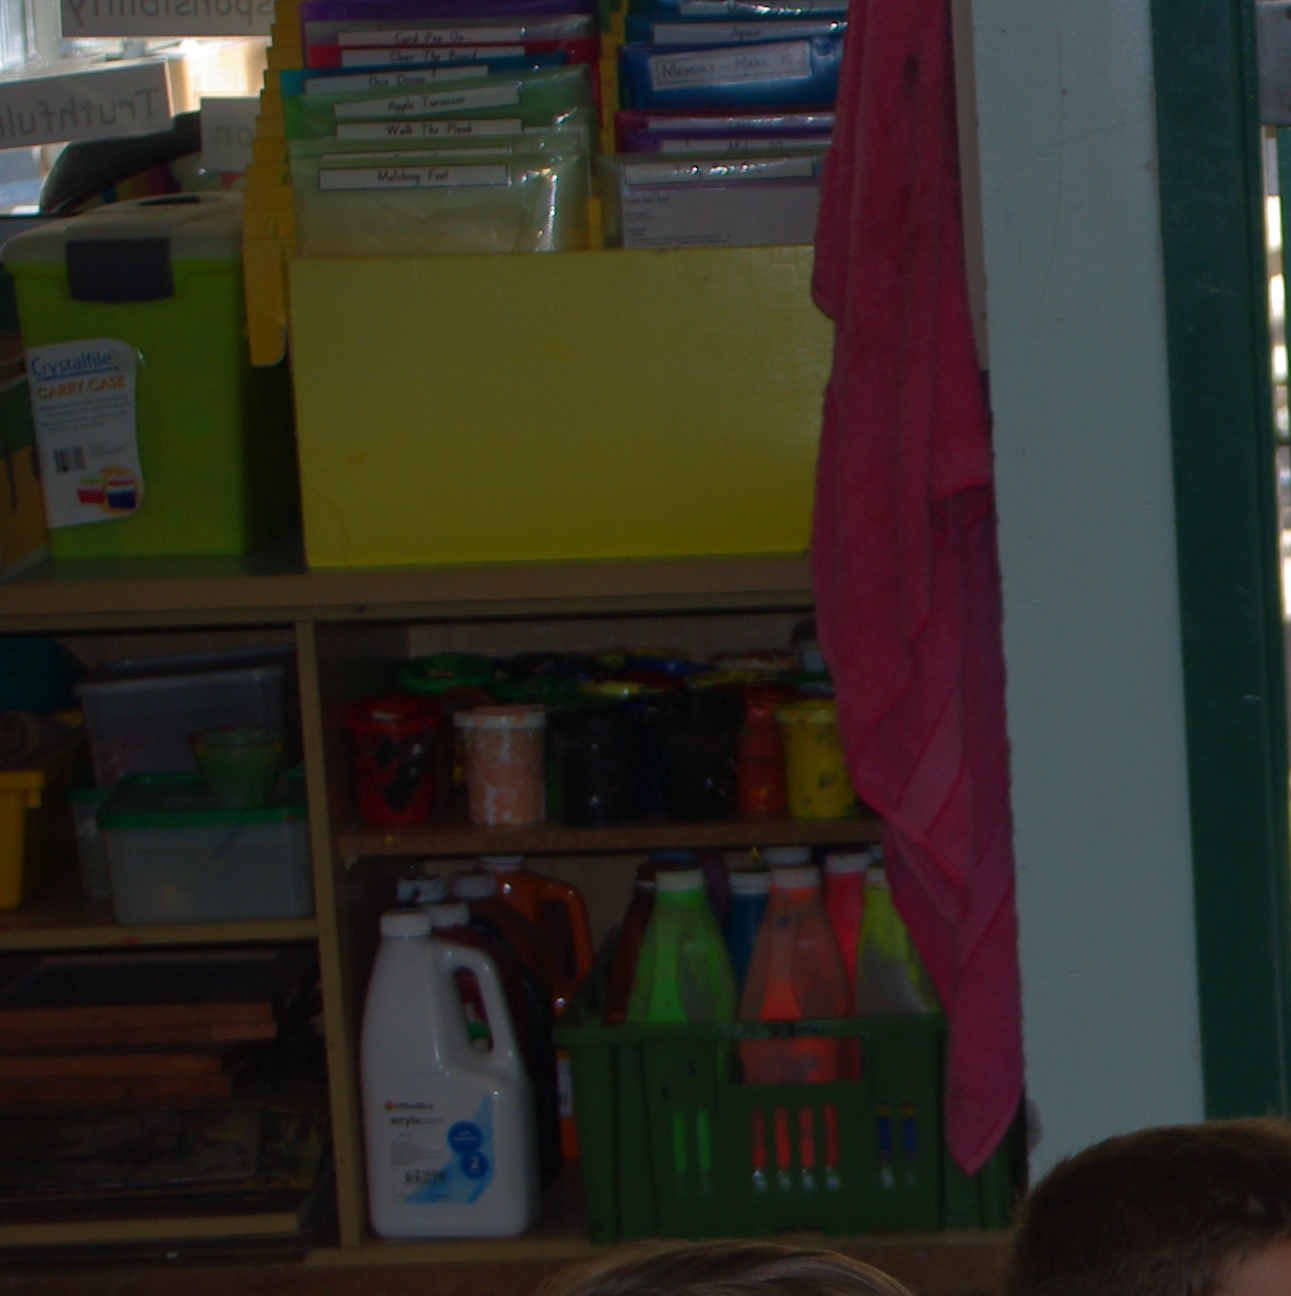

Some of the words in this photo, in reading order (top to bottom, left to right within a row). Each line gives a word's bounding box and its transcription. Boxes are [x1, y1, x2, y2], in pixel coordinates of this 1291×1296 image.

[31, 351, 113, 375] Crystalfile
[37, 381, 83, 399] CARRY
[89, 375, 126, 392] CASE
